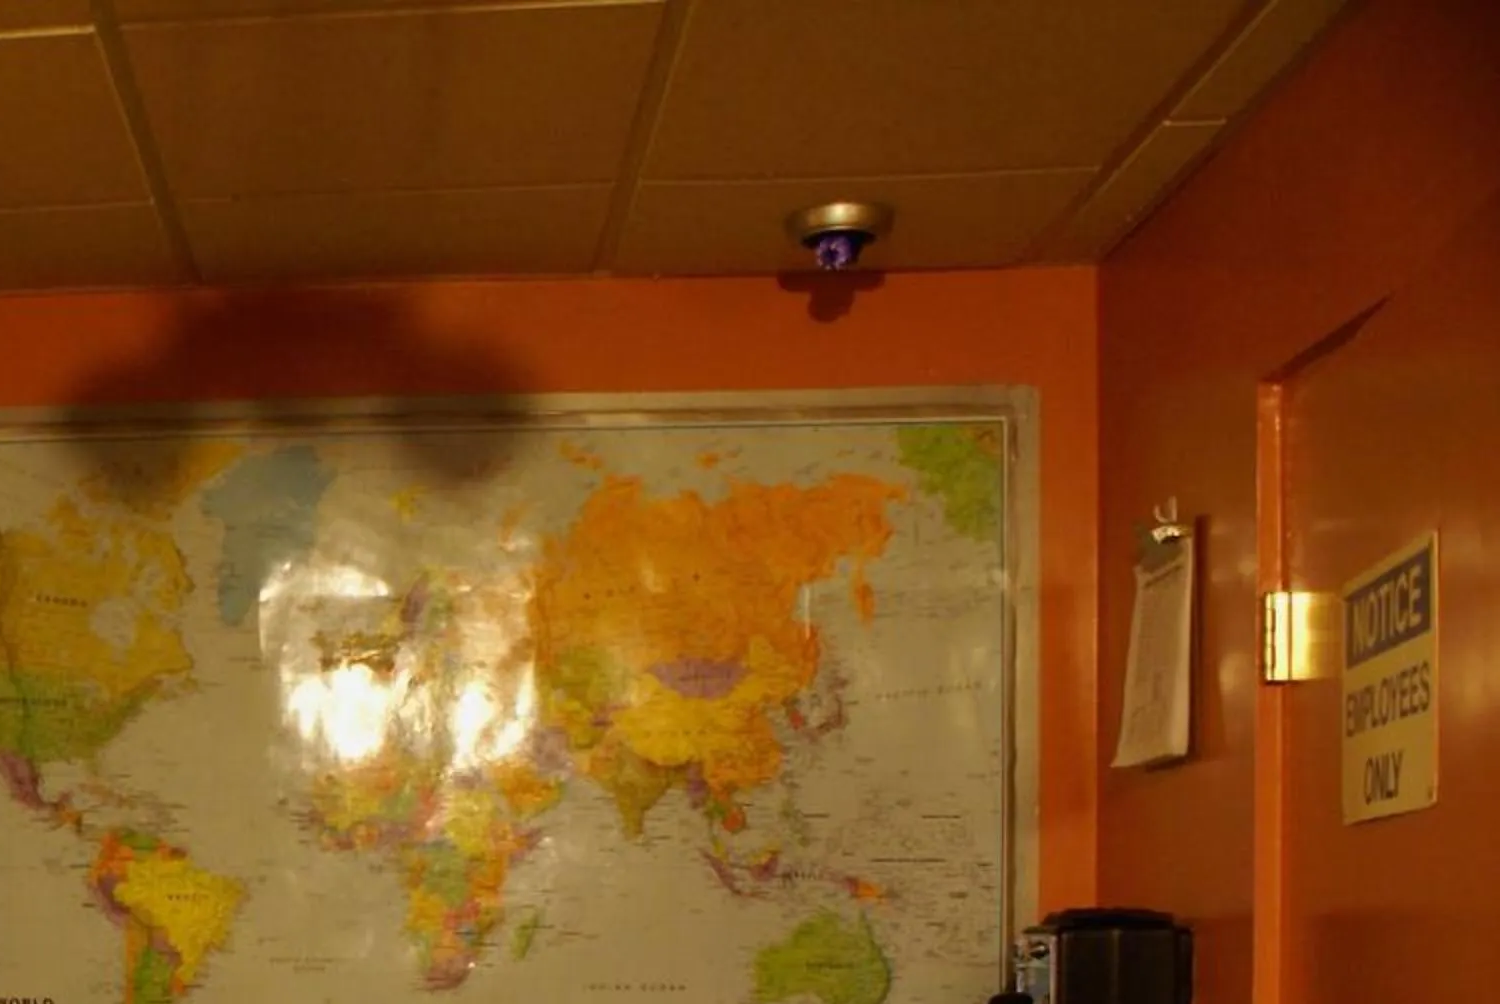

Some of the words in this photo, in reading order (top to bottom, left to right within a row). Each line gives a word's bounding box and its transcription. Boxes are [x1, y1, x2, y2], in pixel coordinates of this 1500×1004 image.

[1353, 563, 1422, 651] NOTICE
[1345, 660, 1430, 738] EMPLOYEES
[1363, 751, 1404, 806] ONLY
